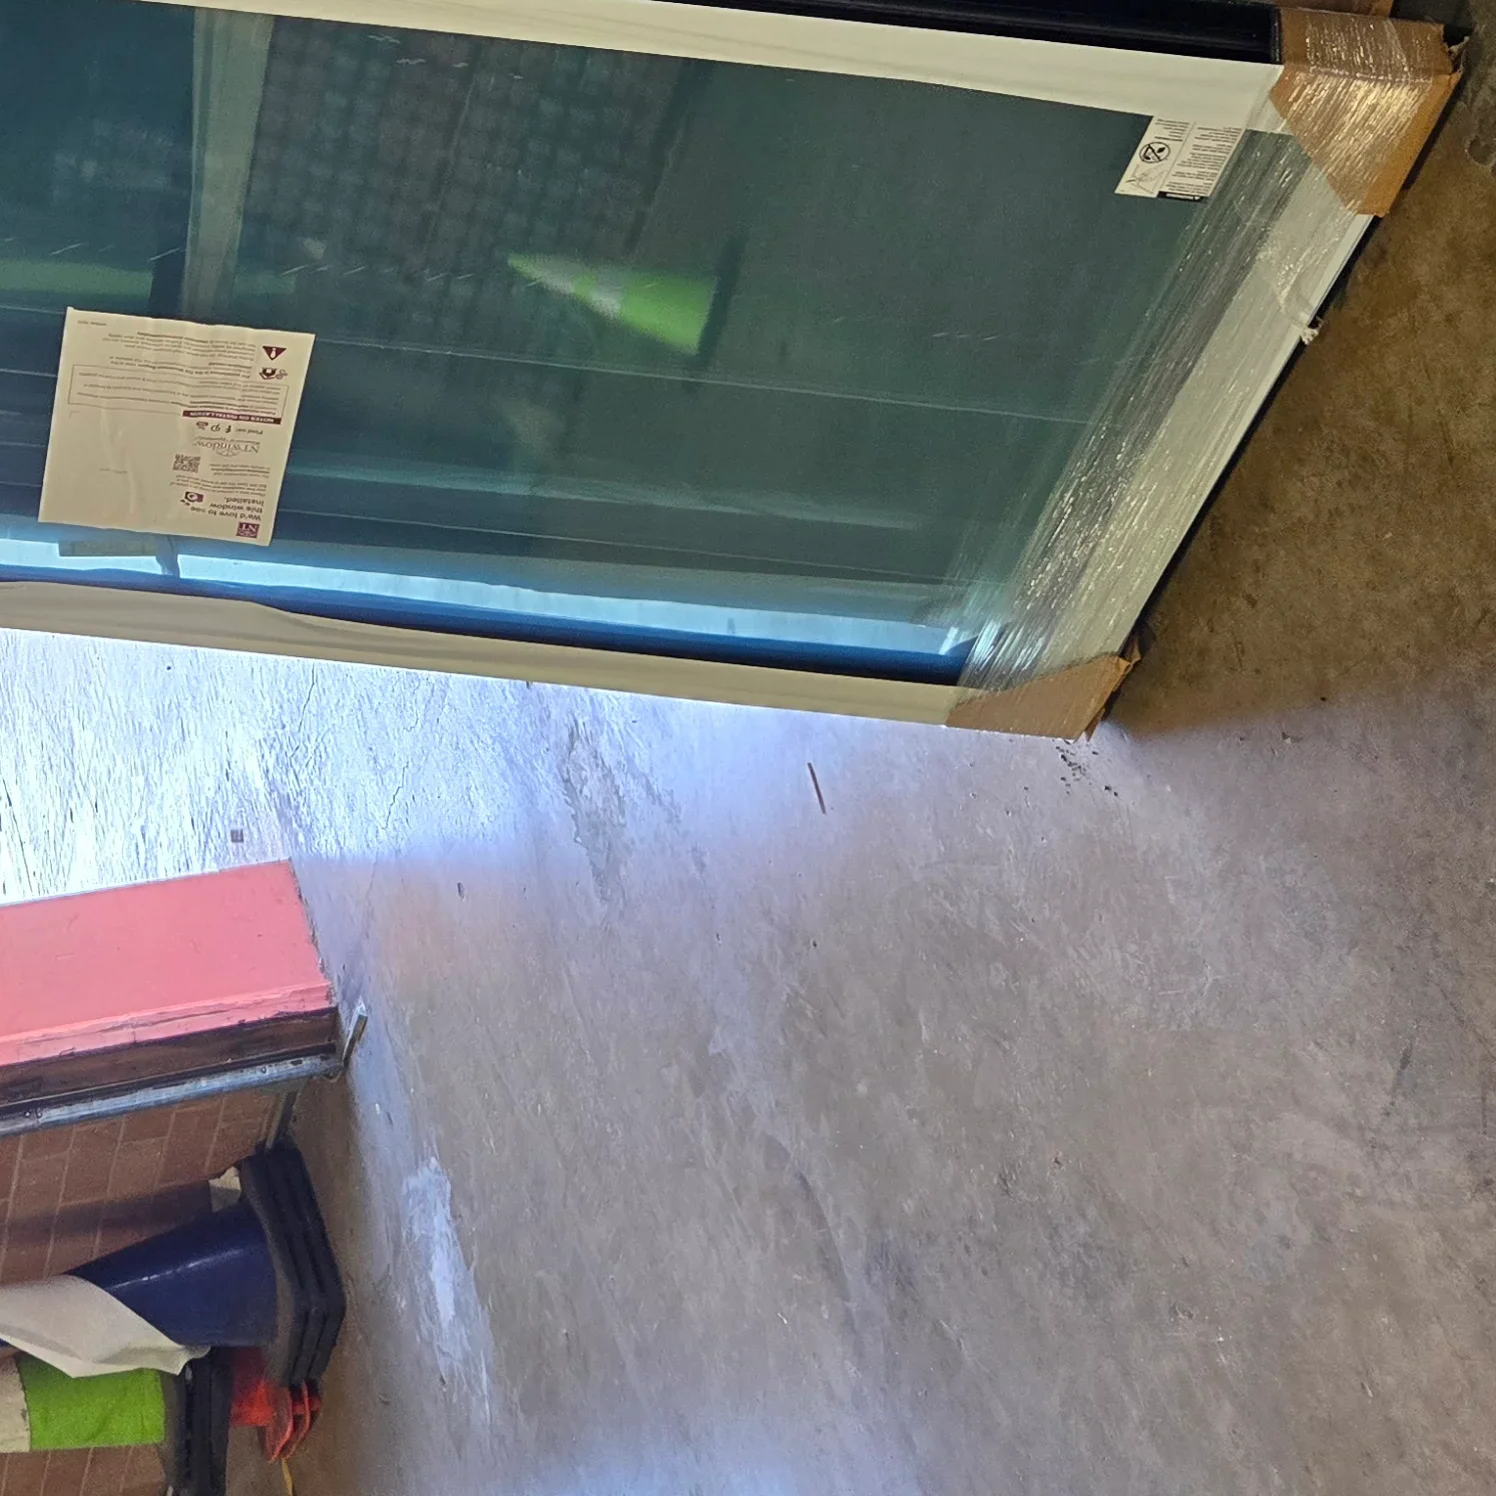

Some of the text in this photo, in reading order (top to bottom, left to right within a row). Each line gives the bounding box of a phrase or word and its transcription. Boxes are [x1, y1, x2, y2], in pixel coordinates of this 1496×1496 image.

[223, 496, 264, 506] installed.
[209, 502, 243, 511] window
[218, 510, 237, 518] love
[239, 512, 261, 520] We'd
